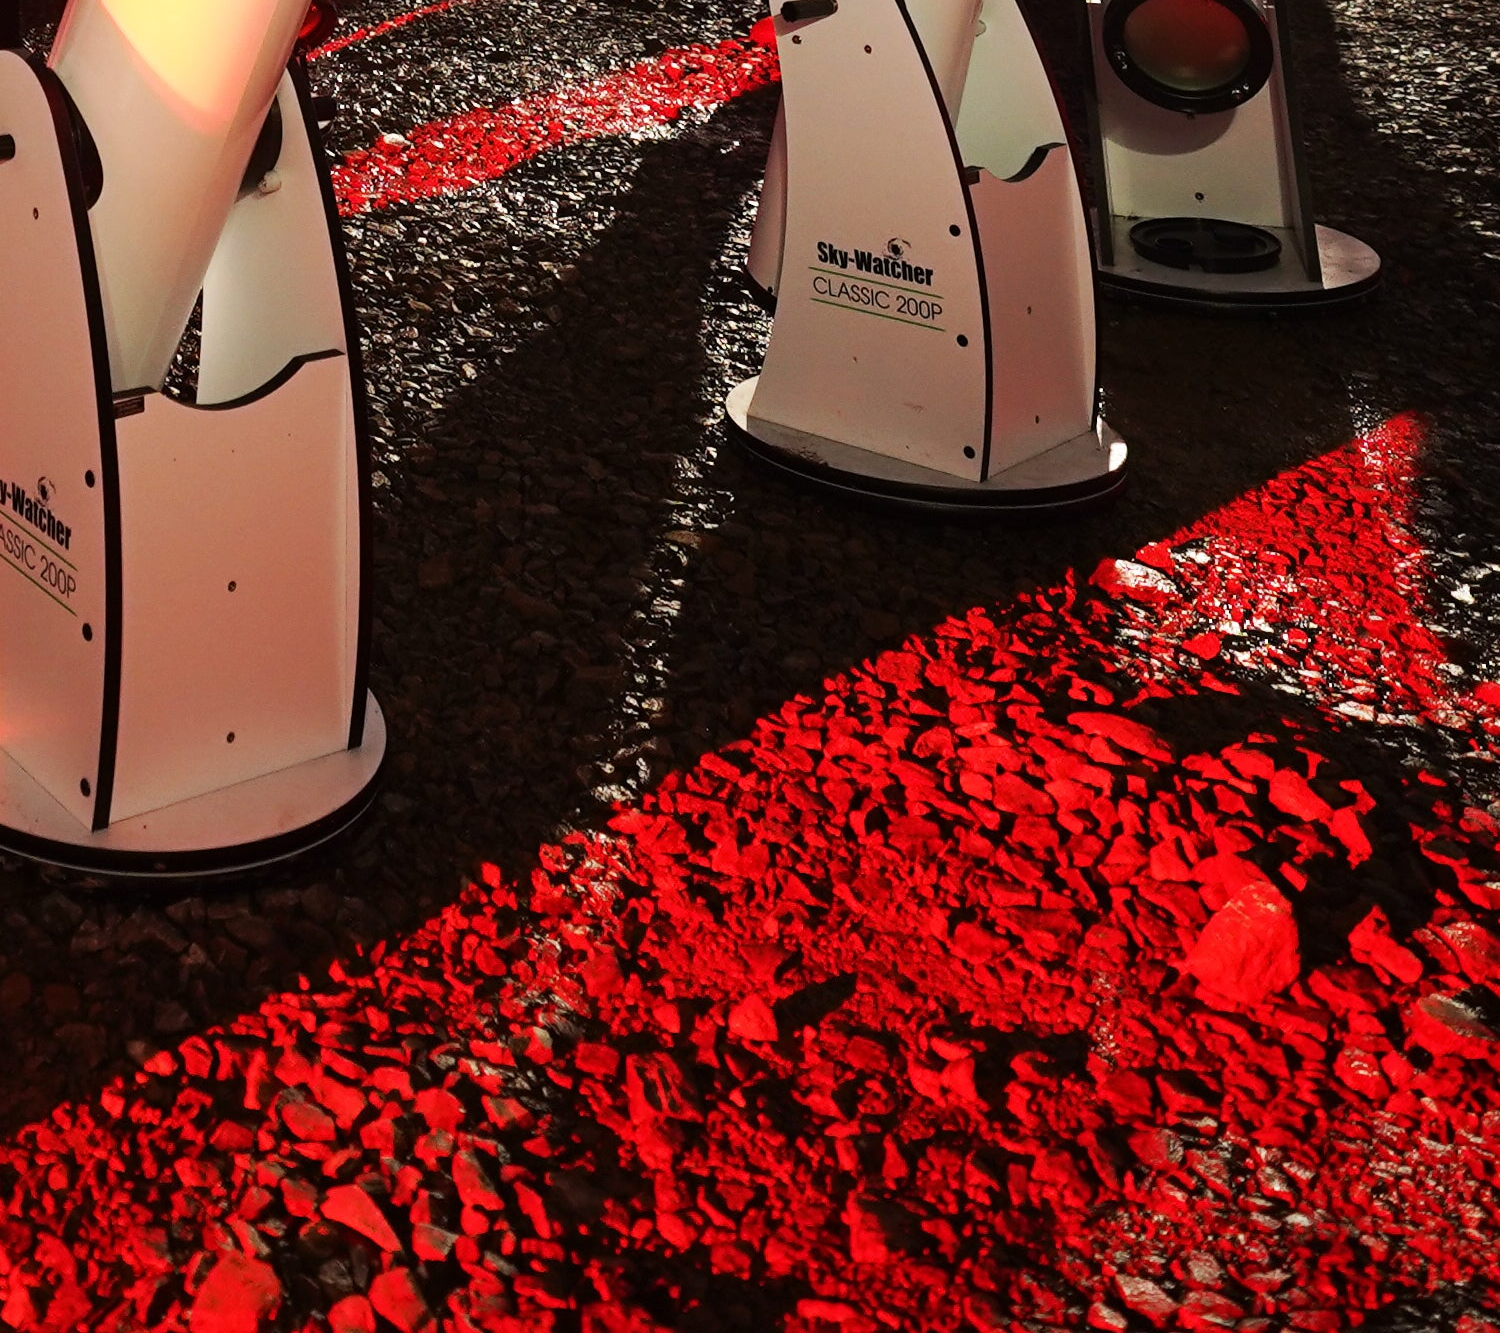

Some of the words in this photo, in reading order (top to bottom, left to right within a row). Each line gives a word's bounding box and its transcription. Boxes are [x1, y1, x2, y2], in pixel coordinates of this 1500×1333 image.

[816, 241, 934, 286] Sky-Watcher
[813, 276, 891, 309] CLASSIC
[896, 295, 943, 321] 200P
[40, 555, 77, 598] 200P
